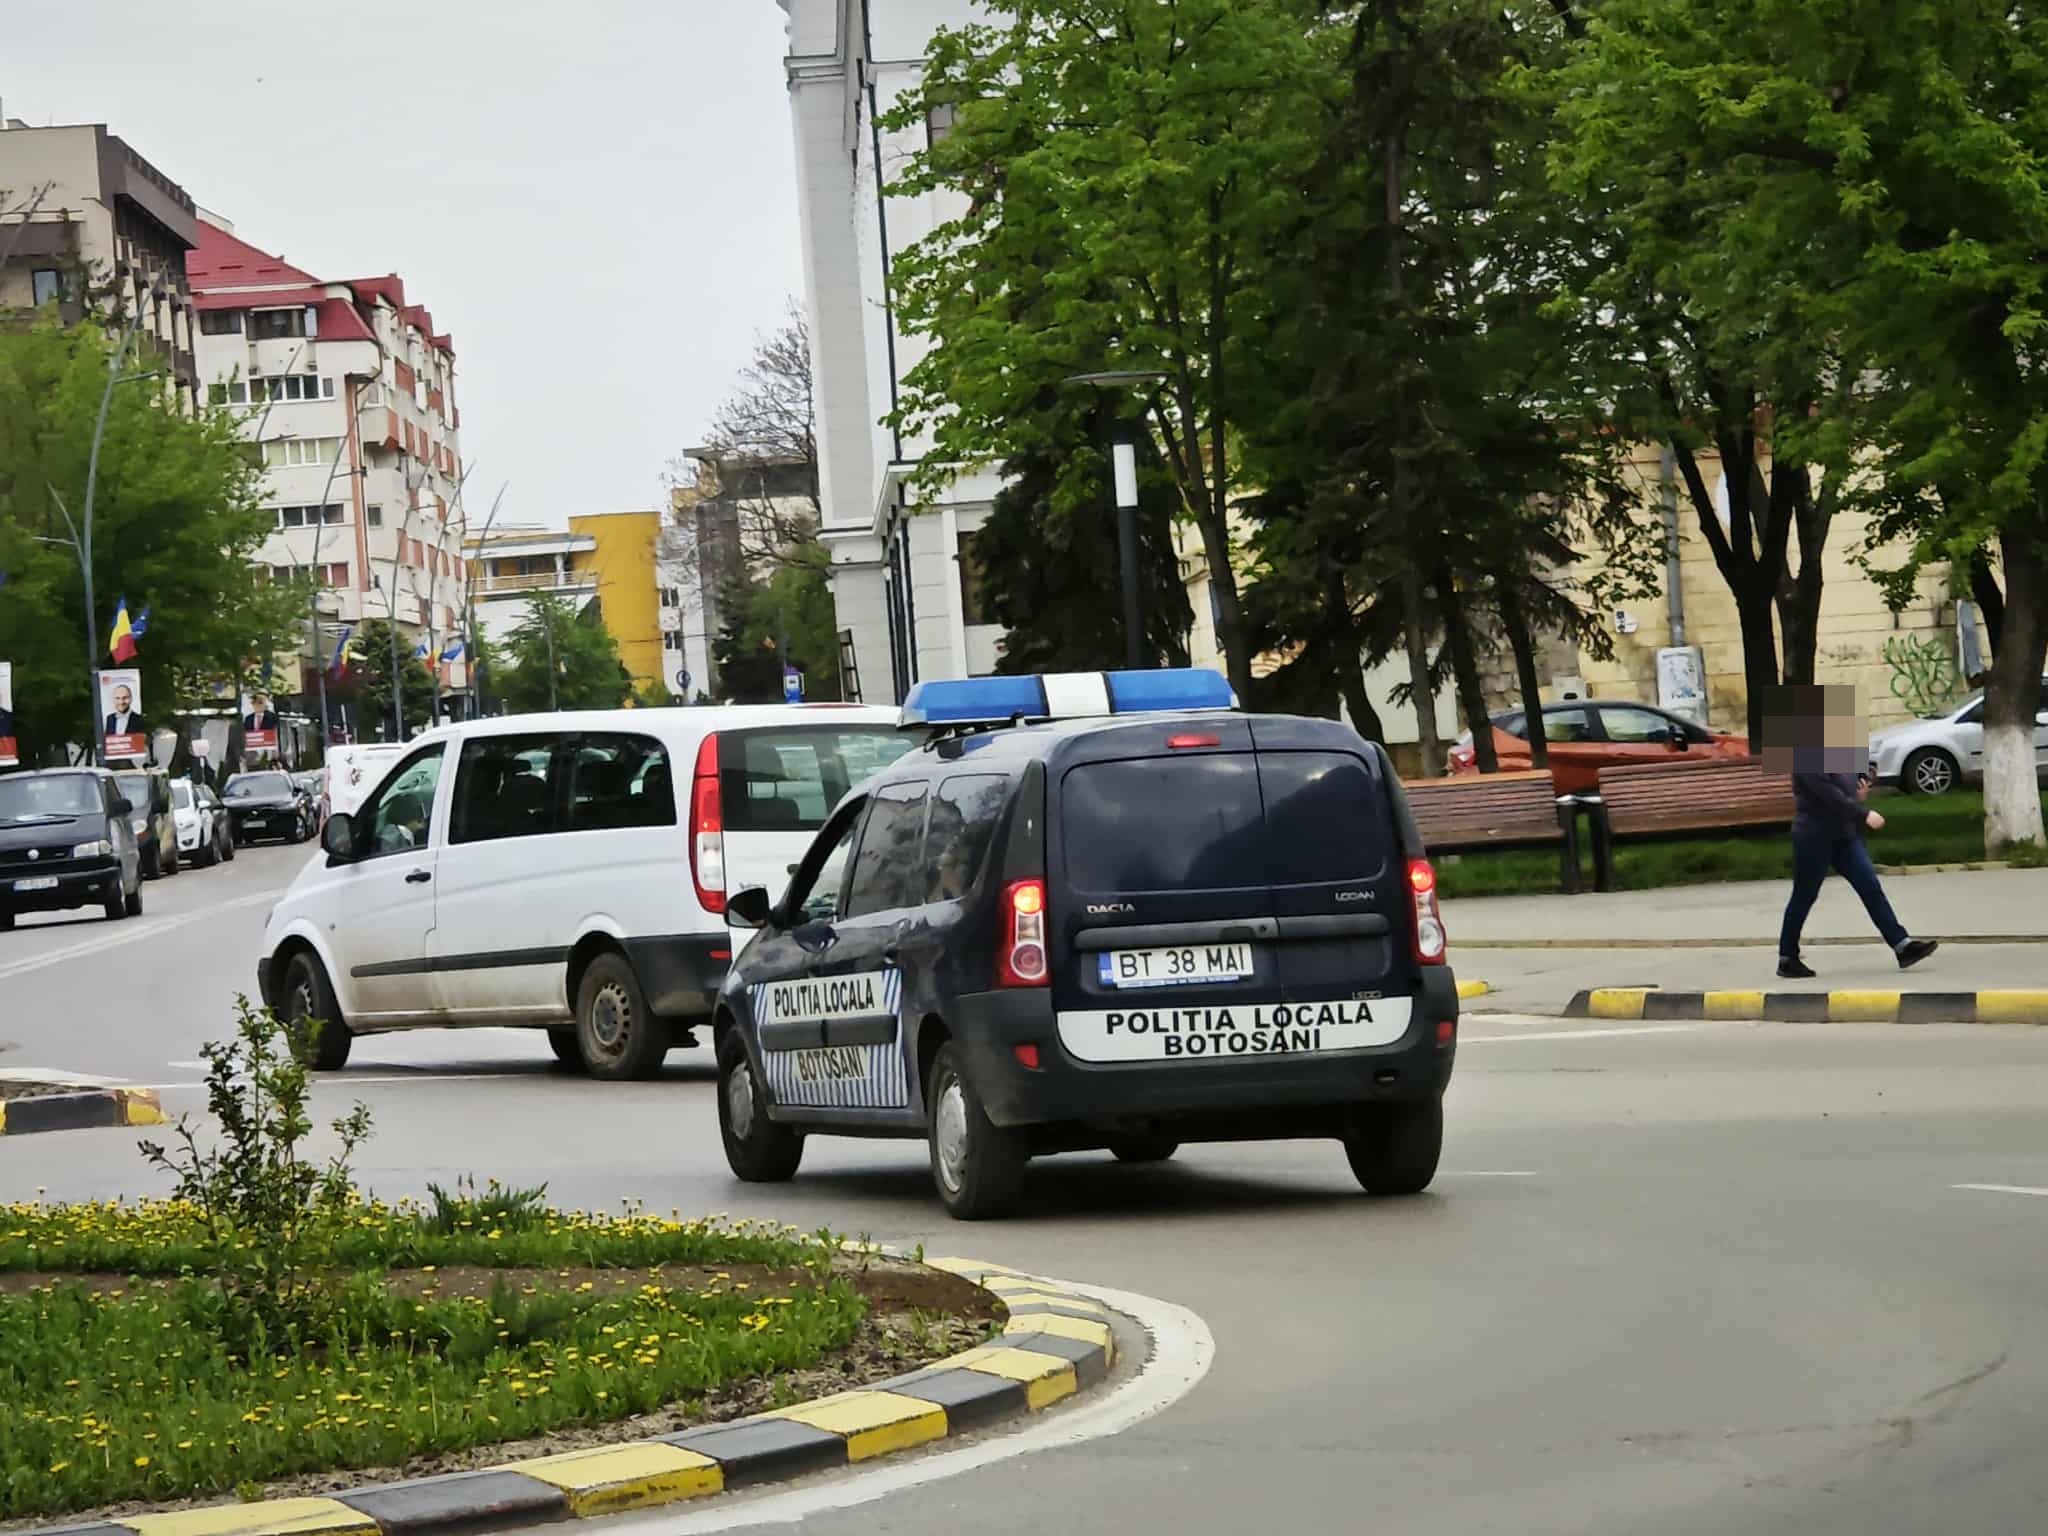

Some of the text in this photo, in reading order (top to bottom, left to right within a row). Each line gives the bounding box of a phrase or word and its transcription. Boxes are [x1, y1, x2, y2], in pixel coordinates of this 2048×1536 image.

[1119, 946, 1245, 978] BT 38 MAI
[774, 978, 875, 1017] POLITIA LOCALA
[1106, 1002, 1374, 1034] POLITIA LOCALA
[1164, 1028, 1321, 1056] BOTOSANI
[797, 1048, 864, 1081] BOTOSANI
